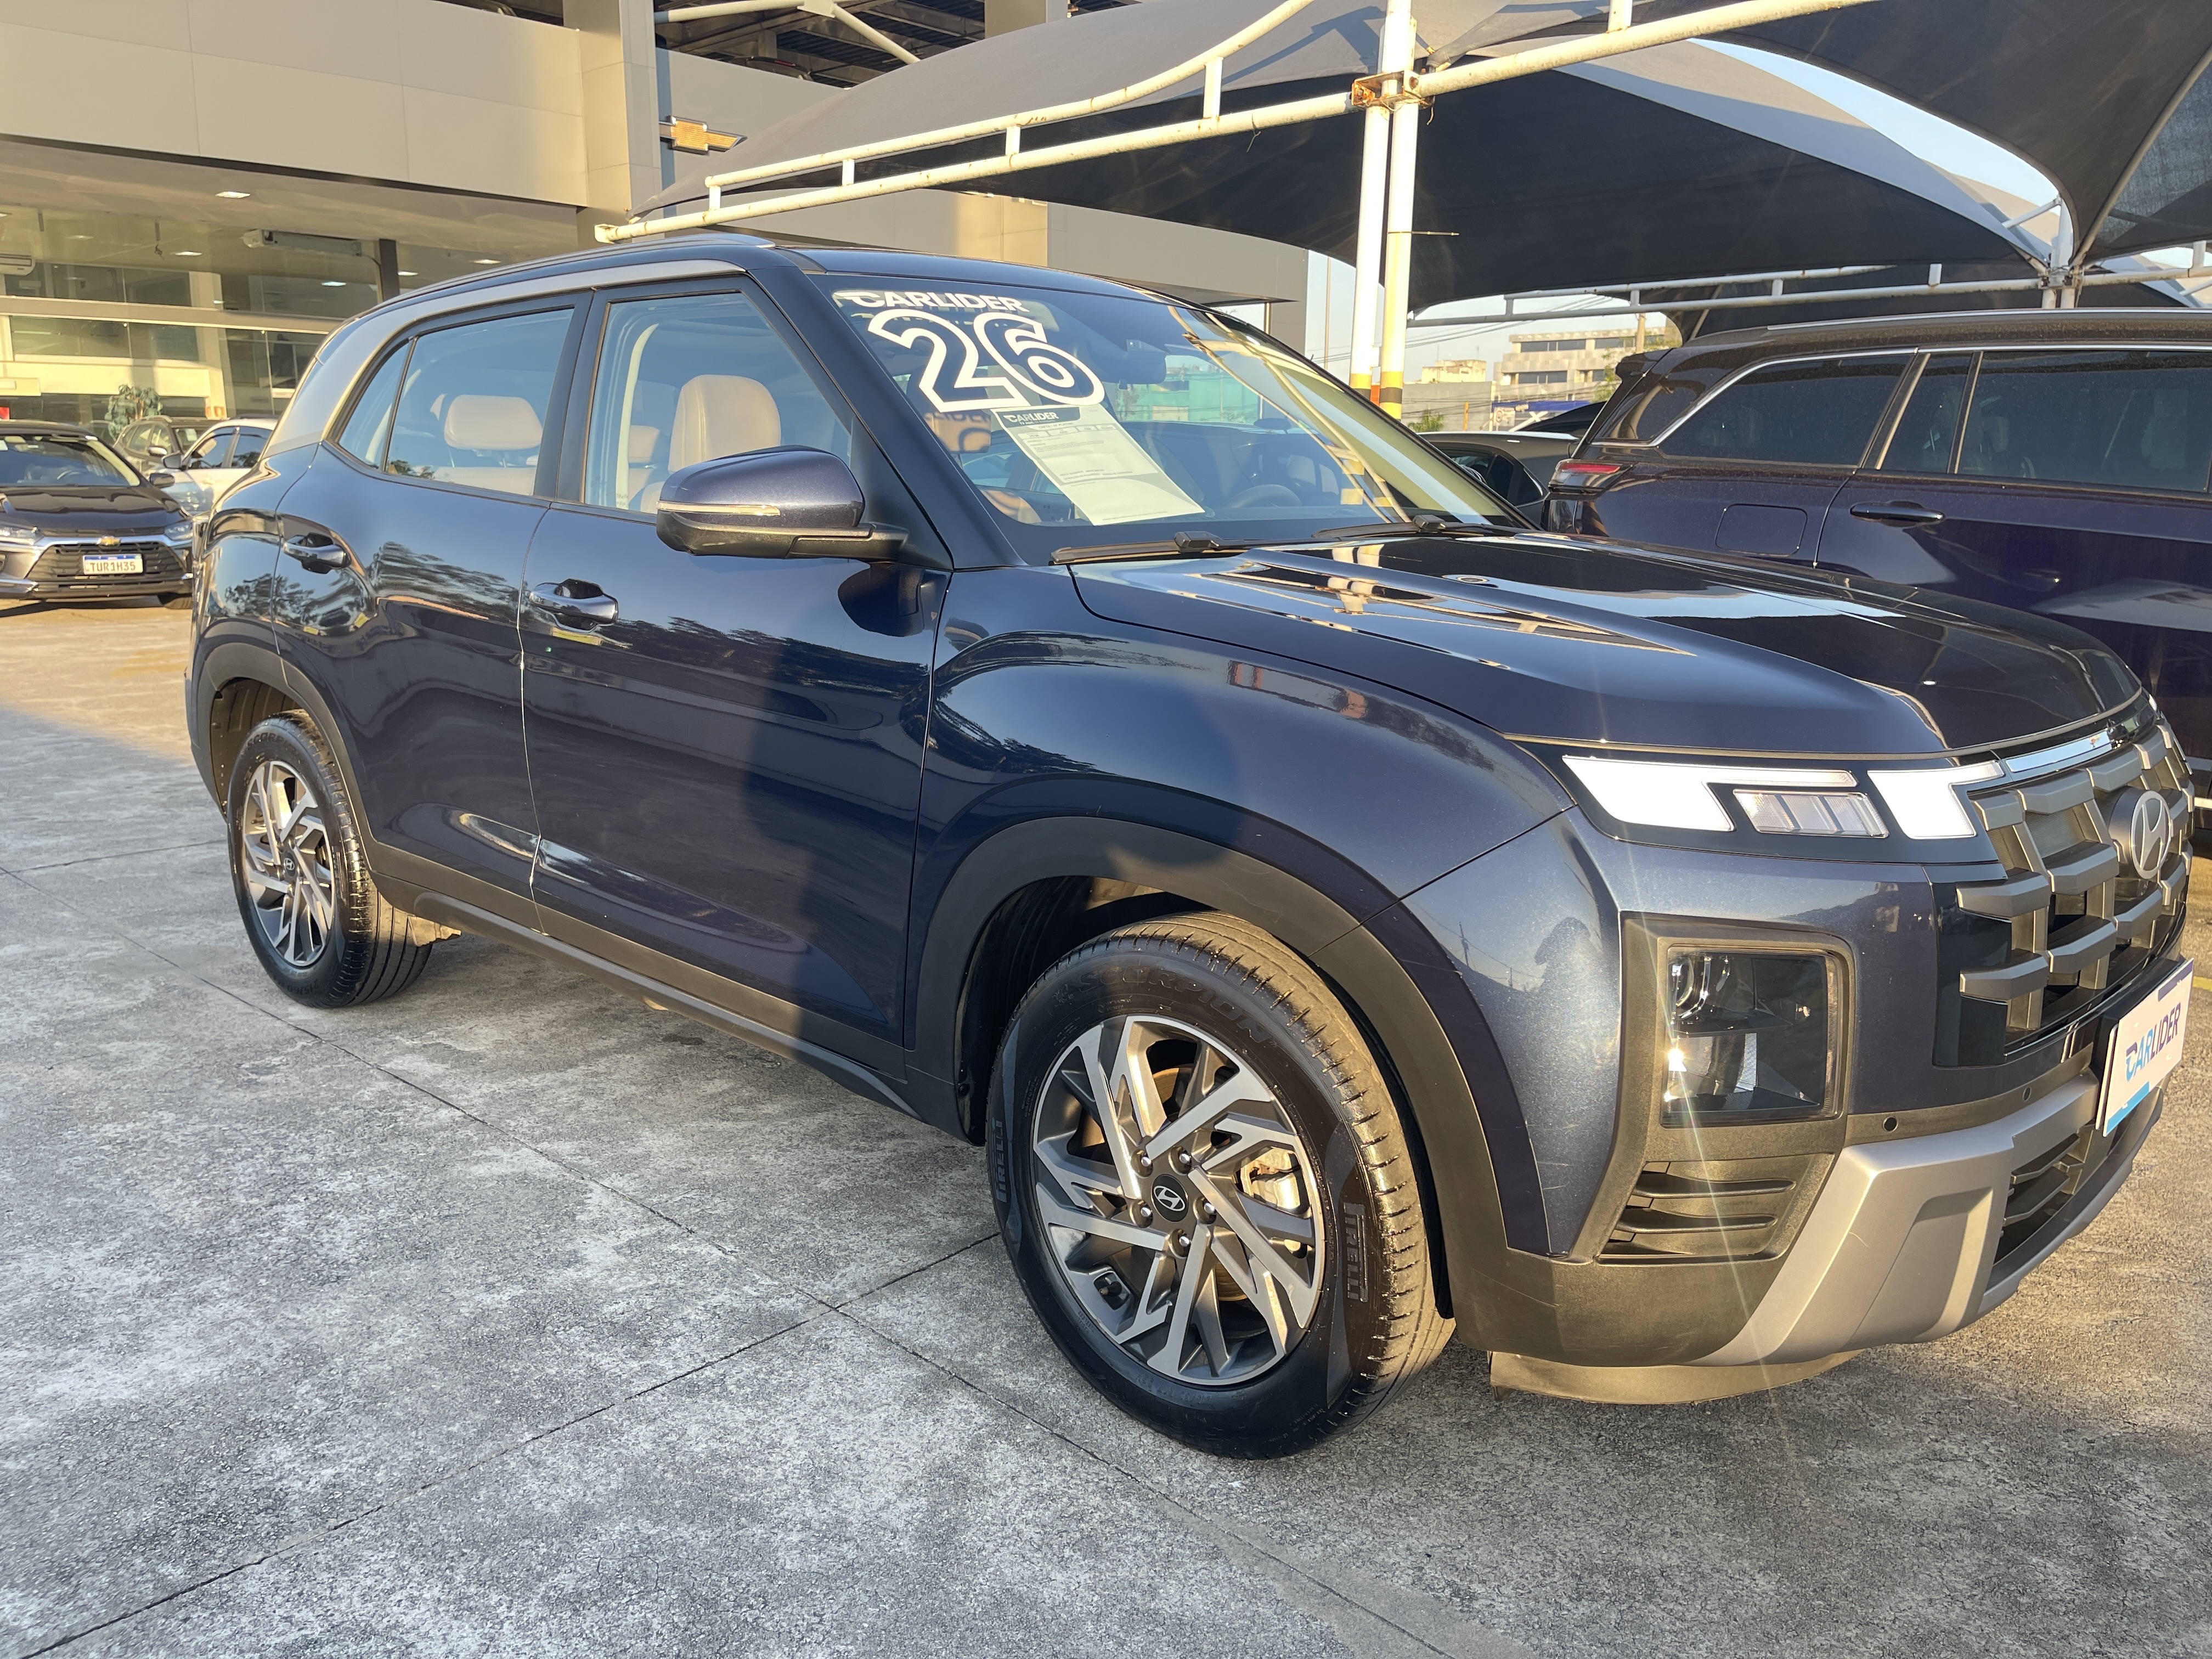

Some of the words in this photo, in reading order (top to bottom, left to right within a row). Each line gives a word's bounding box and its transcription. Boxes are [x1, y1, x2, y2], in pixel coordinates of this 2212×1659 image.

[834, 291, 1030, 312] CARLIDER
[868, 308, 1105, 413] 26
[1003, 411, 1059, 424] CARLIDER
[89, 561, 136, 572] TUR1H35
[2125, 1002, 2181, 1082] CARLIDER
[1344, 1202, 1369, 1302] PIRELLI
